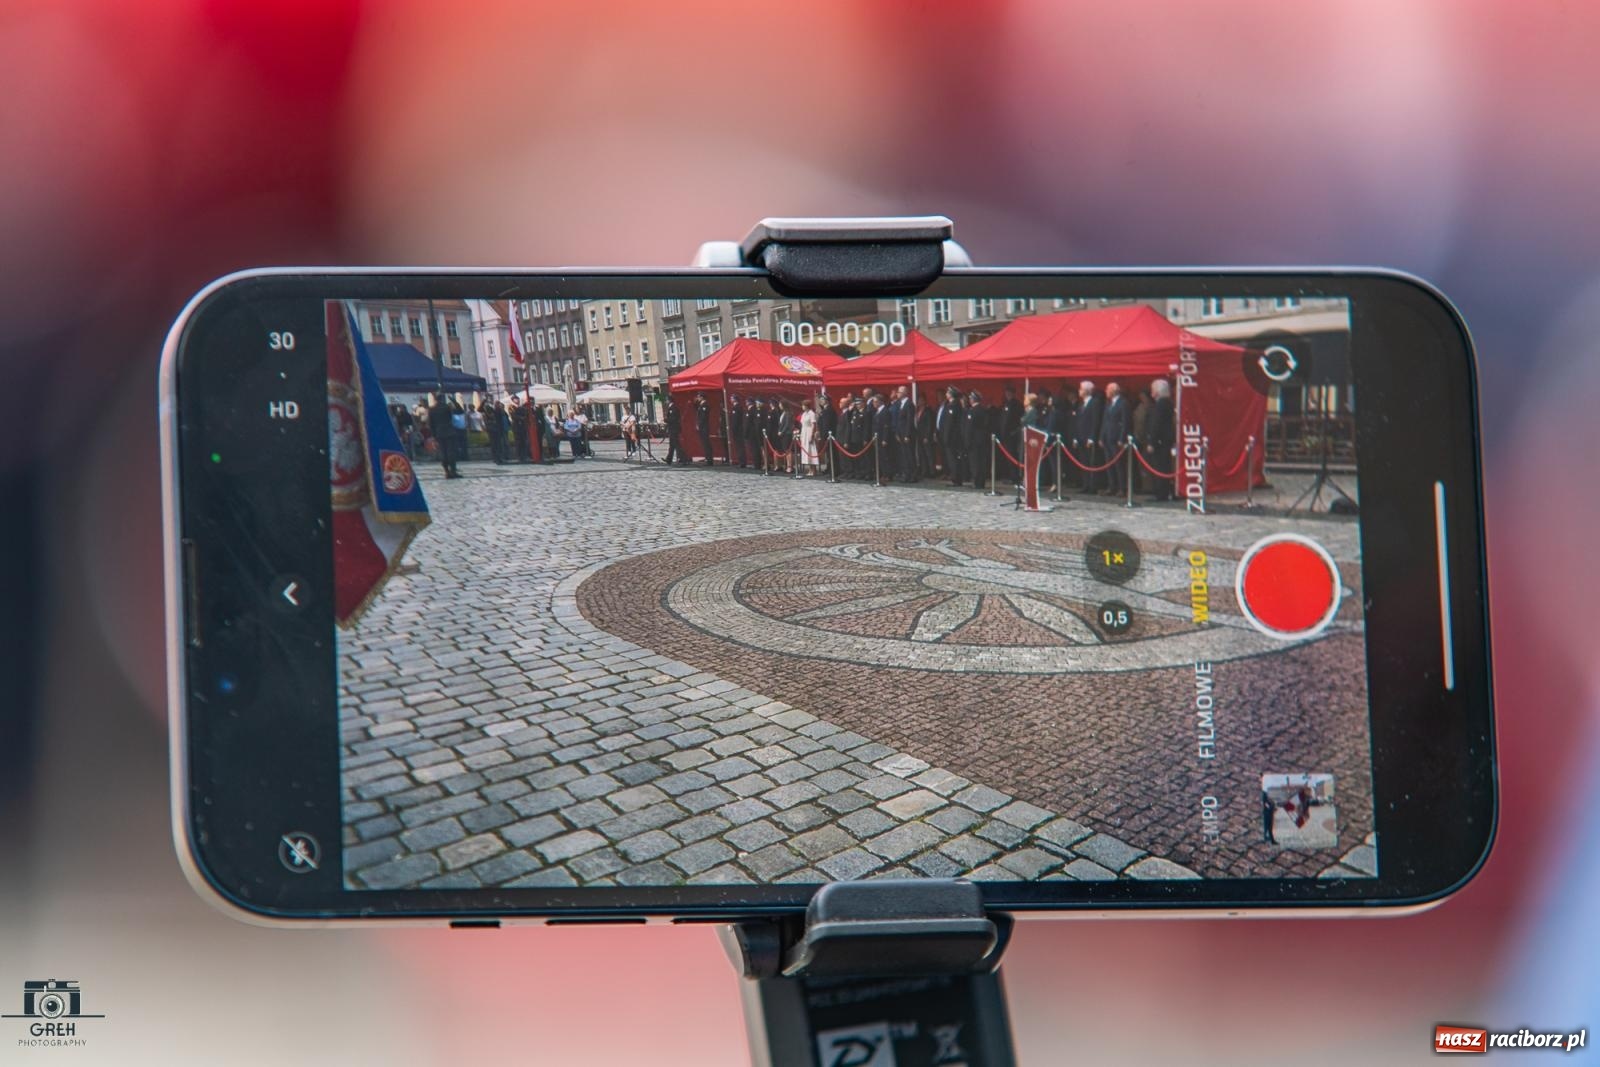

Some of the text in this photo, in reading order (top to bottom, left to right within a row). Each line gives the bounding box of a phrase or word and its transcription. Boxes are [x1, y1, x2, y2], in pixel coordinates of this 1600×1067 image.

[269, 332, 295, 350] 30
[779, 322, 906, 347] 00:00:00
[269, 401, 299, 419] HD
[1183, 424, 1205, 514] ZDJĘCIE
[1189, 550, 1209, 623] WIDEO
[1103, 611, 1128, 627] 0,5
[1194, 661, 1216, 759] FILMOWE
